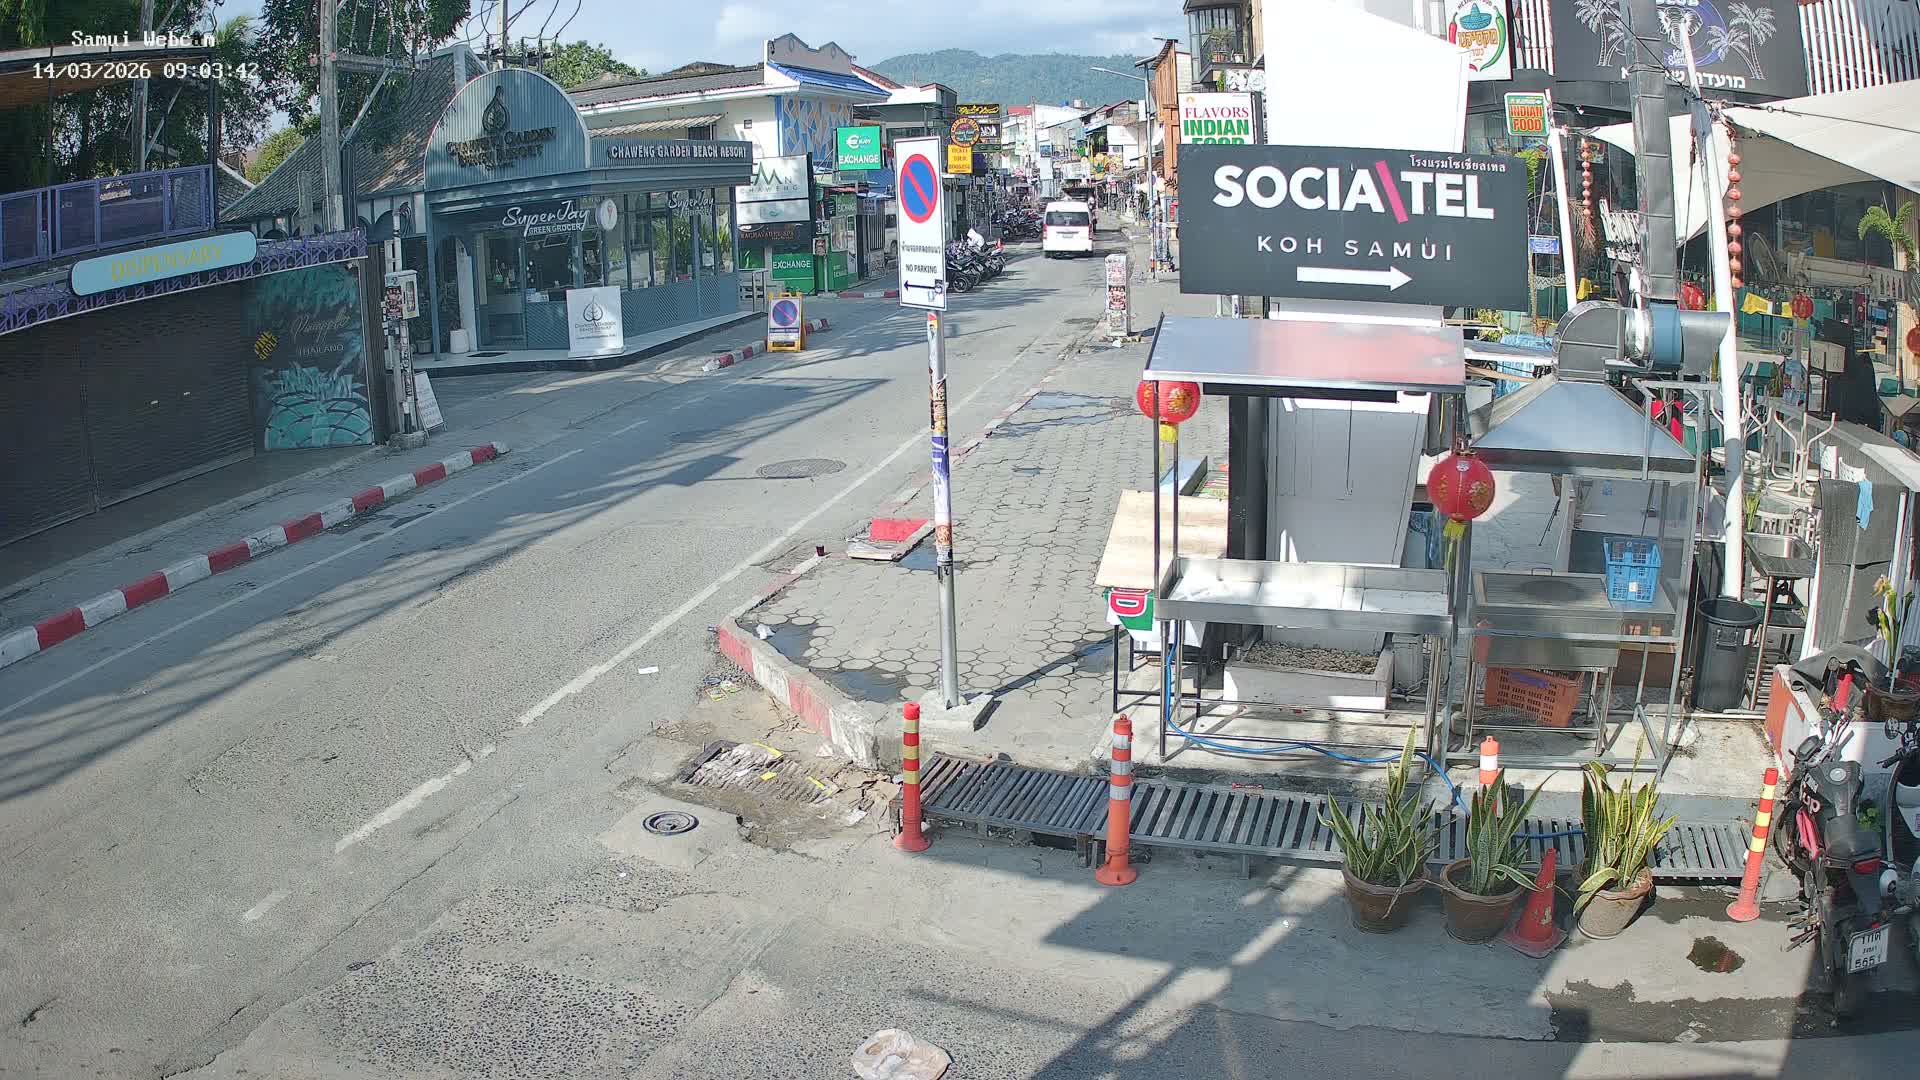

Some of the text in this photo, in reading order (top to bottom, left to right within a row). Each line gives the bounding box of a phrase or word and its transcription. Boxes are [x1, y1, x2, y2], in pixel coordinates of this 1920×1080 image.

[1185, 107, 1249, 118] FLAVORS
[1510, 105, 1543, 117] INDIAN
[1183, 119, 1249, 136] INDIAN
[1513, 118, 1543, 131] FOOD
[611, 145, 747, 158] CHAWENG GARDEN BEACH RESORT
[839, 154, 879, 164] EXCHANGE
[528, 225, 551, 235] GREEN
[1257, 235, 1452, 261] KOH SAMUI
[111, 242, 223, 282] DISPENSARY
[773, 260, 811, 269] EXCHANGE
[905, 263, 938, 274] NO PARKING
[299, 343, 344, 357] THAILAND
